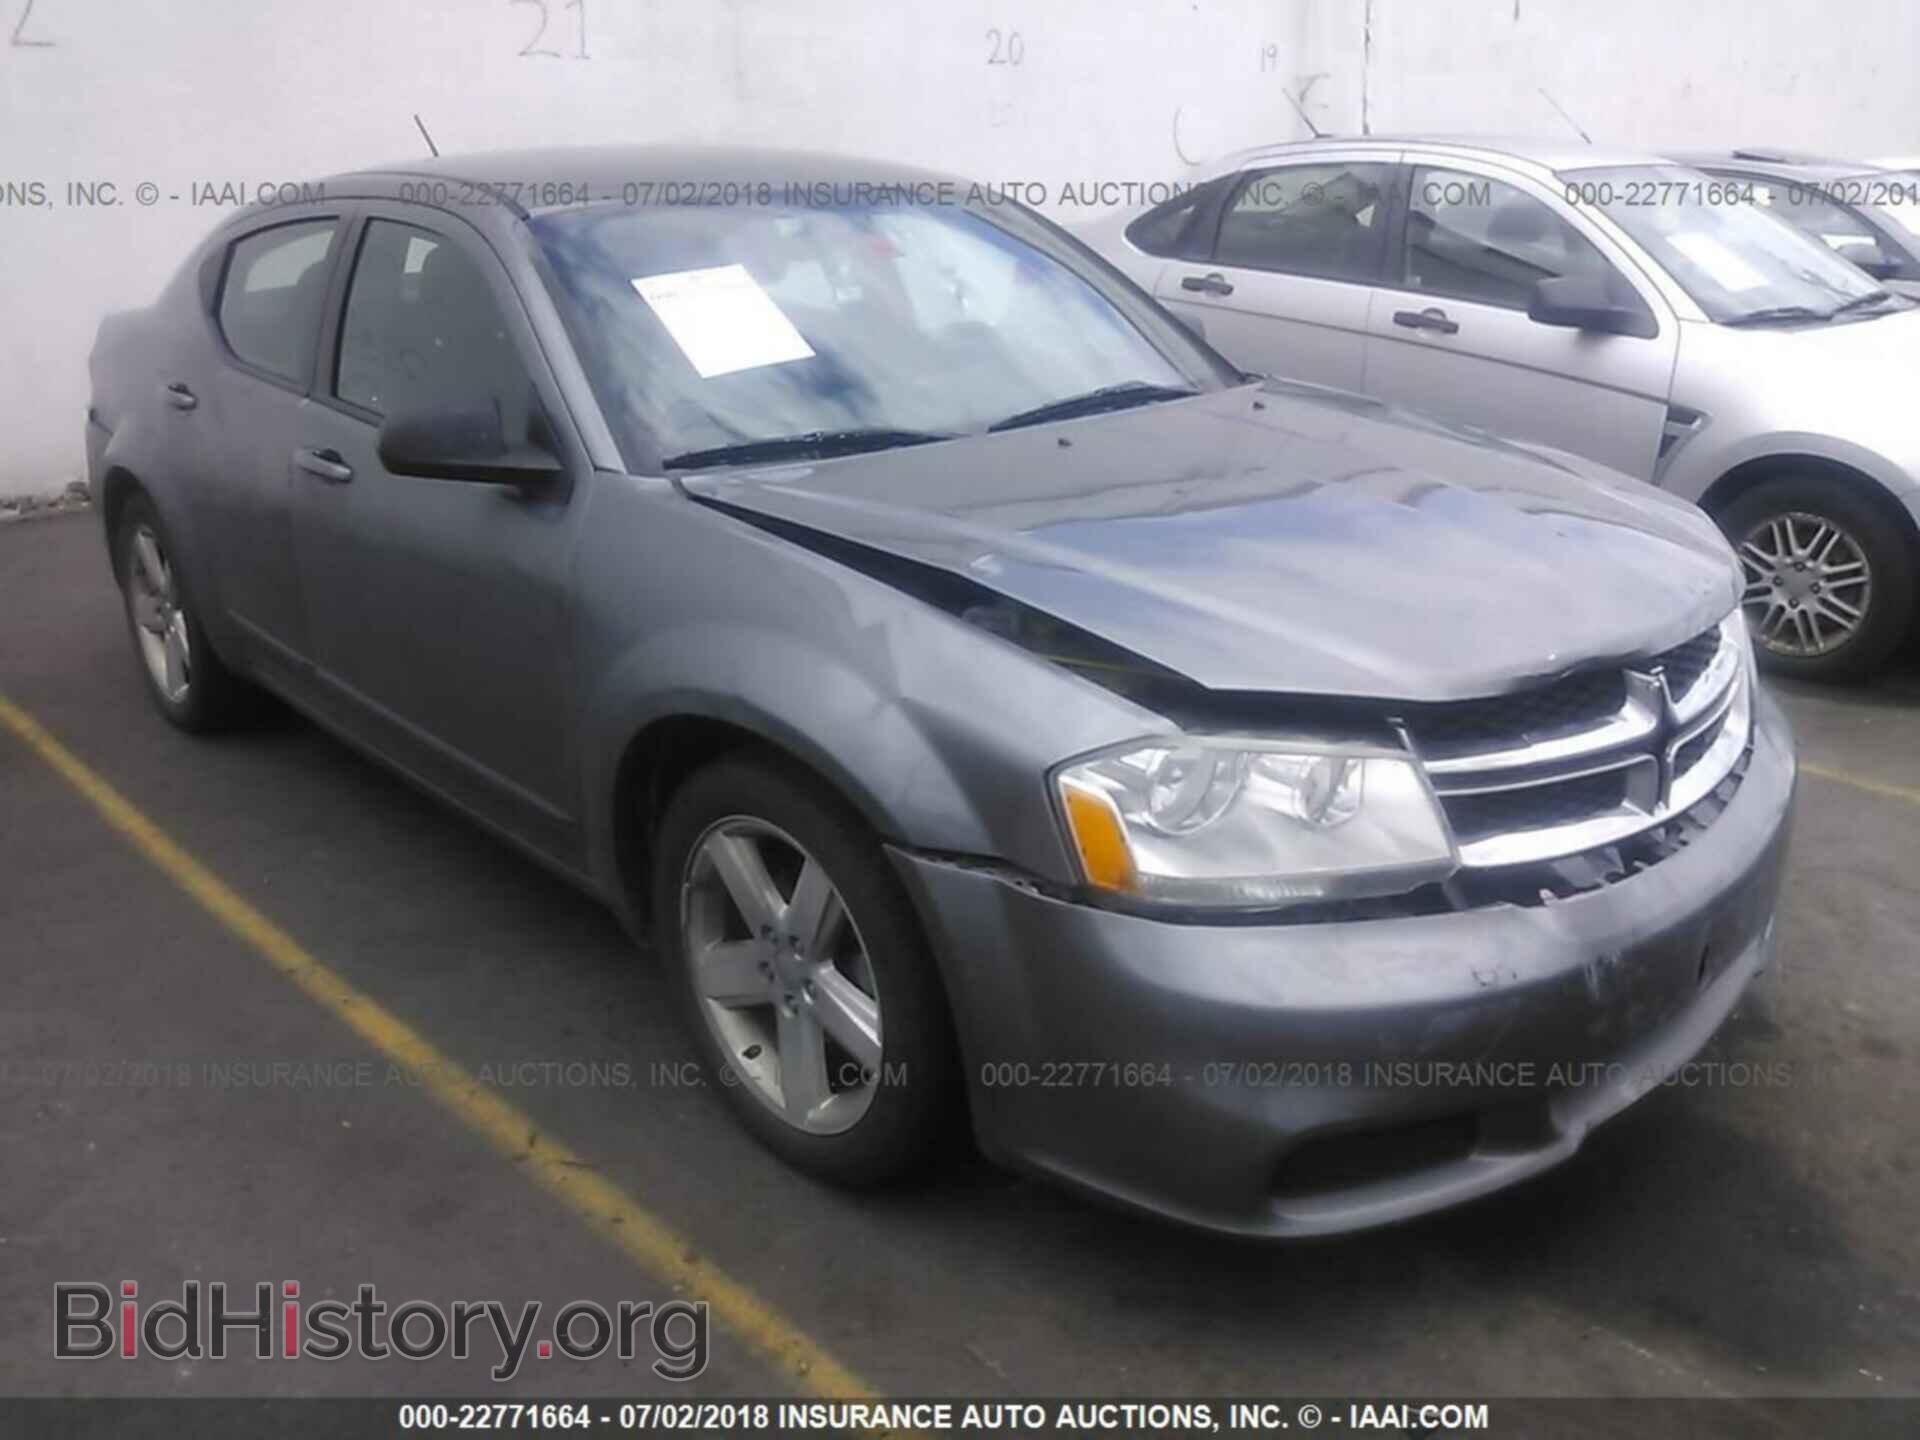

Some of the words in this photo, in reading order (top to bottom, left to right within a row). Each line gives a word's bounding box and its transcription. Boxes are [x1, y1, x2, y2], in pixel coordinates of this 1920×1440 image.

[509, 0, 593, 60] 21
[985, 28, 1025, 67] 20
[1260, 43, 1279, 73] 19
